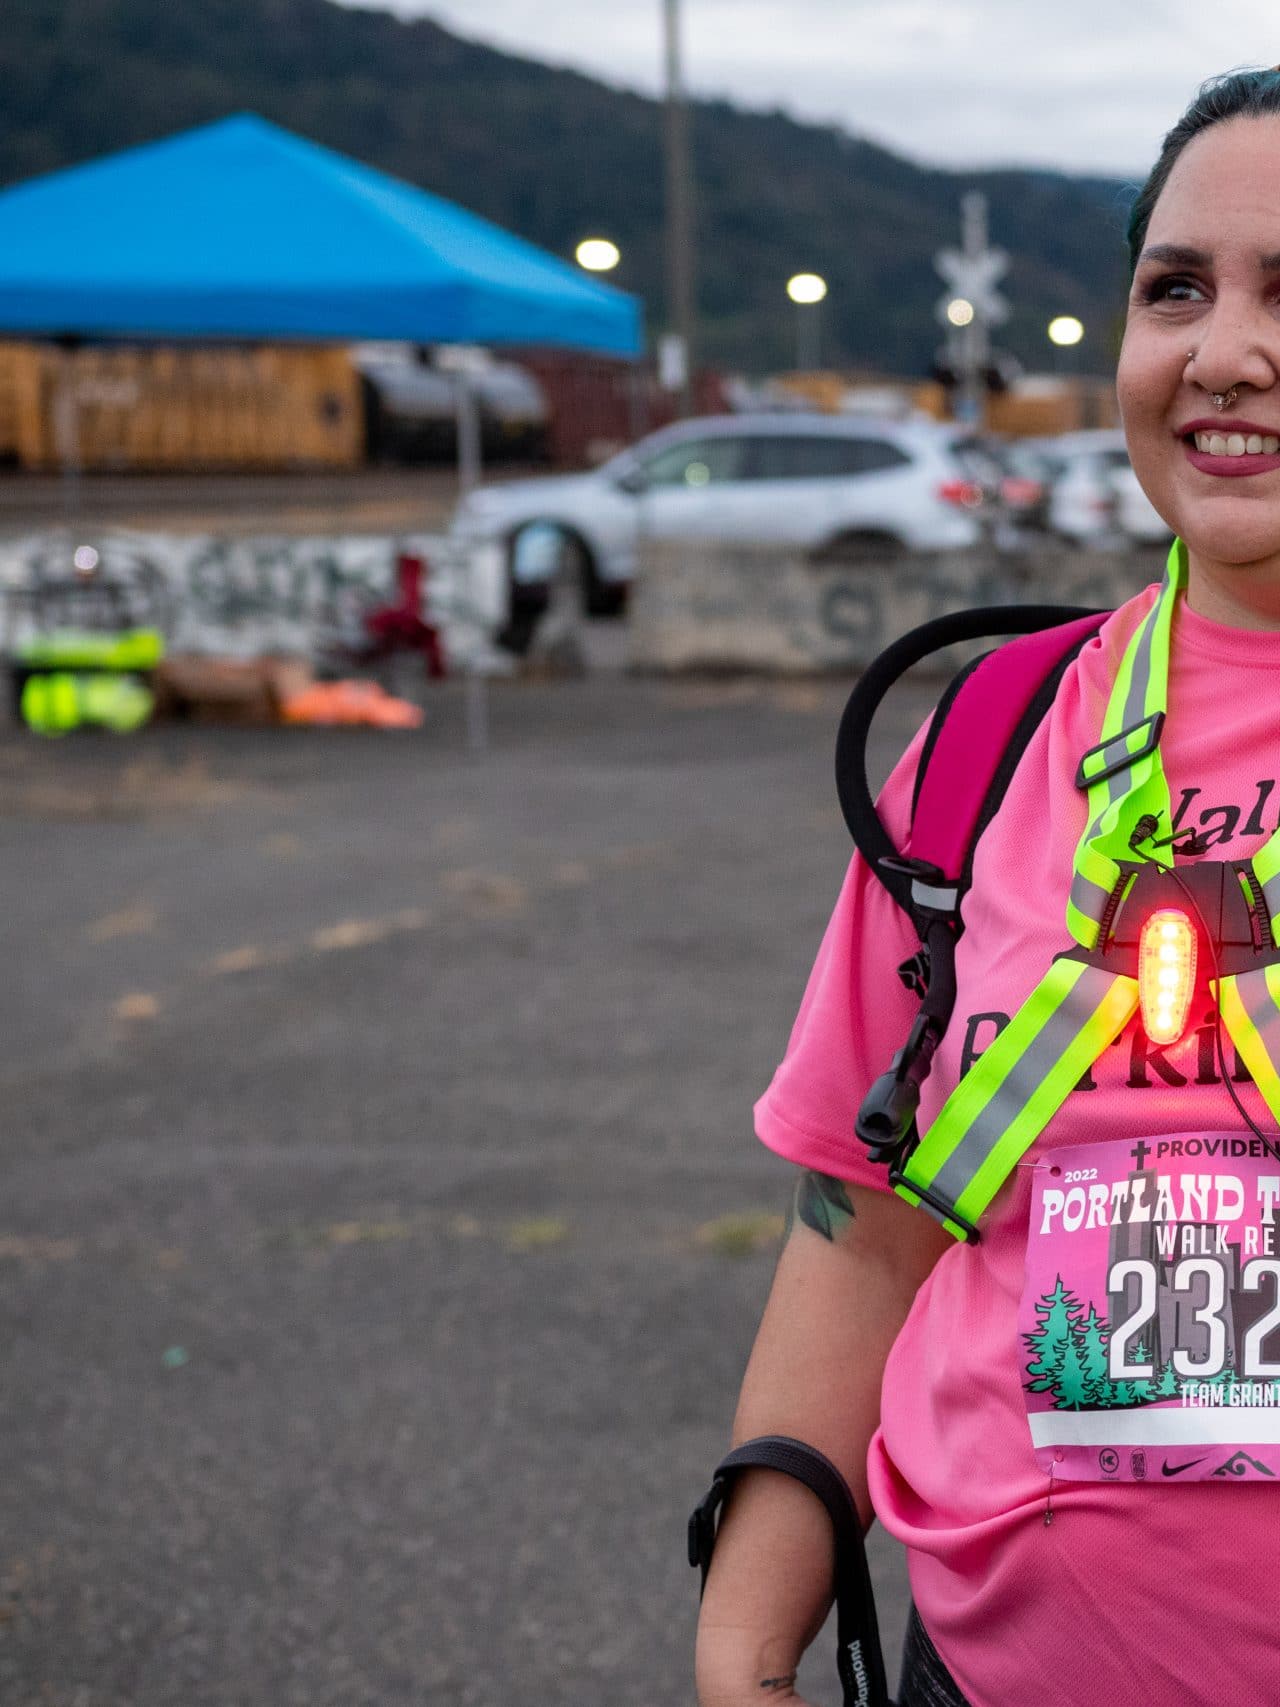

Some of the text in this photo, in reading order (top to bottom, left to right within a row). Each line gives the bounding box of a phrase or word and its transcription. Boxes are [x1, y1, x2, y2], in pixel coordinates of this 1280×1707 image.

[1064, 1168, 1098, 1183] 2022
[1039, 1173, 1245, 1235] PORTLAND
[1156, 1224, 1230, 1255] WALK
[1180, 1383, 1224, 1407] TEAM
